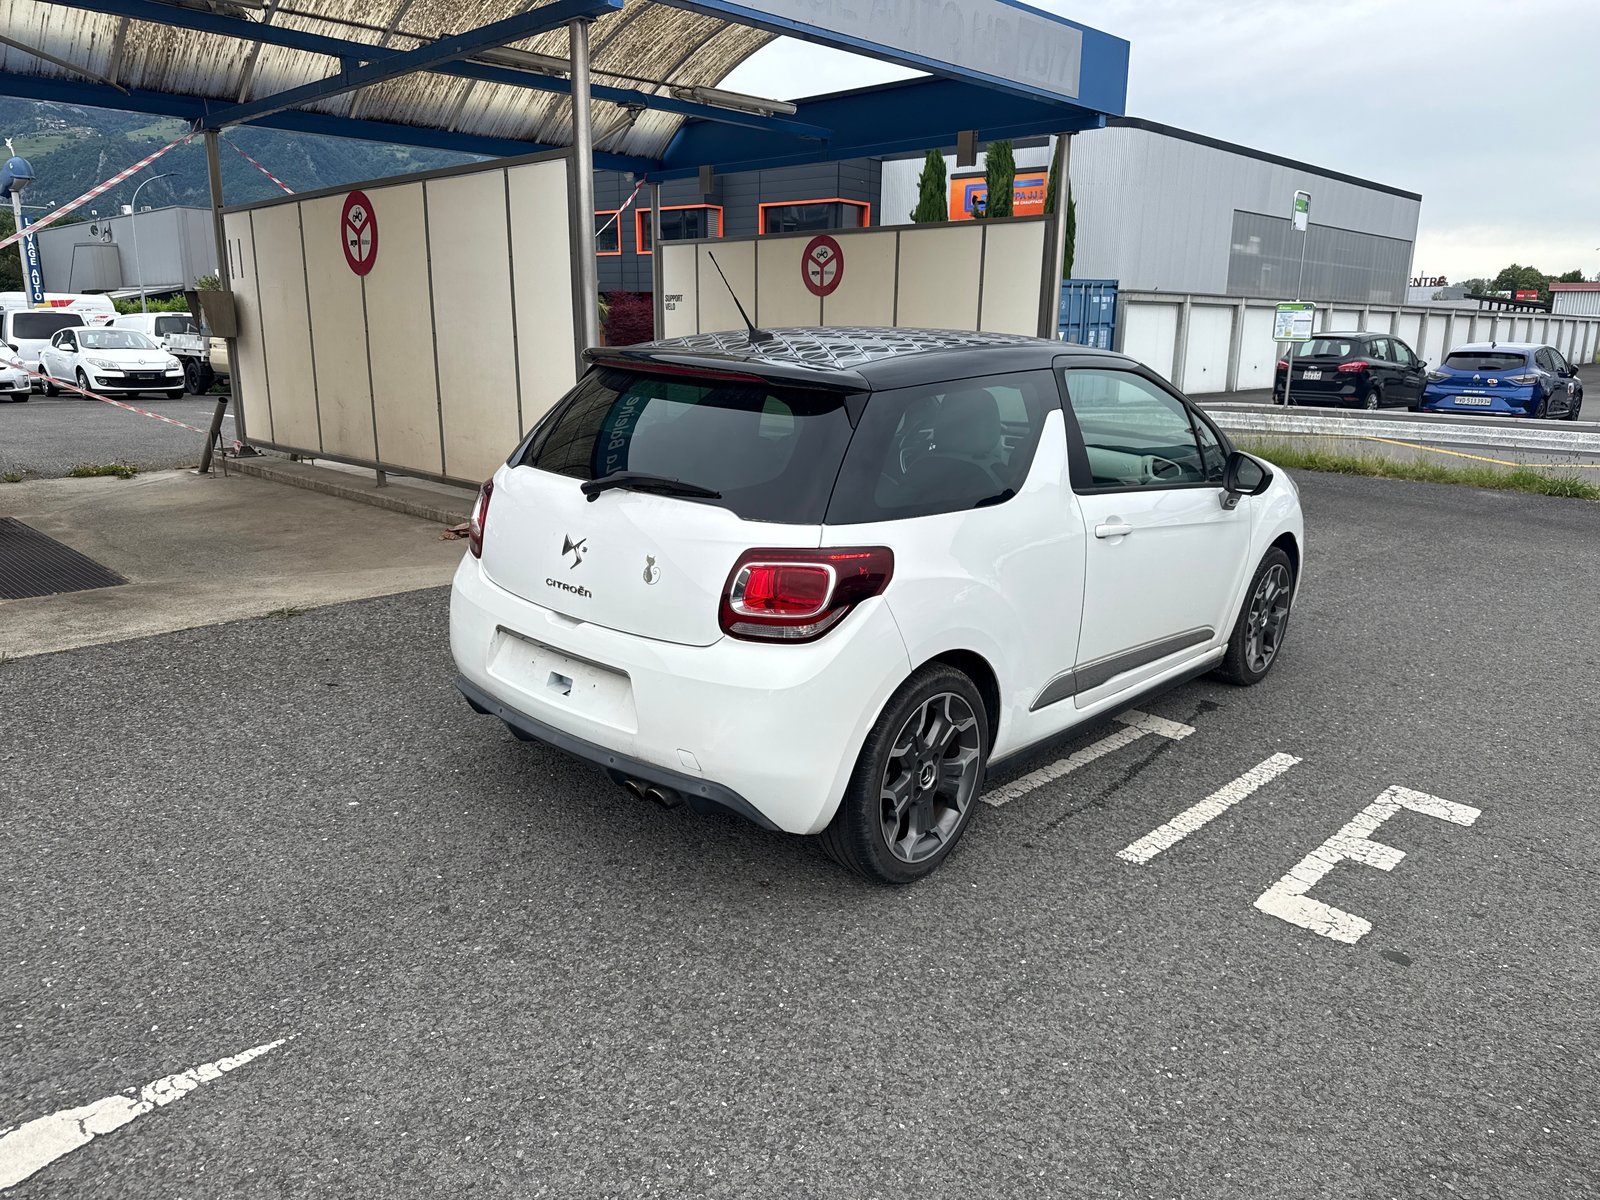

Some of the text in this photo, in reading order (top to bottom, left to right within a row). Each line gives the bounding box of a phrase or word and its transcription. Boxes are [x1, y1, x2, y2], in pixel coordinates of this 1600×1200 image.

[24, 217, 43, 301] LVAGE AUTO
[665, 294, 683, 303] SUPPORT
[545, 577, 592, 599] CITROËN
